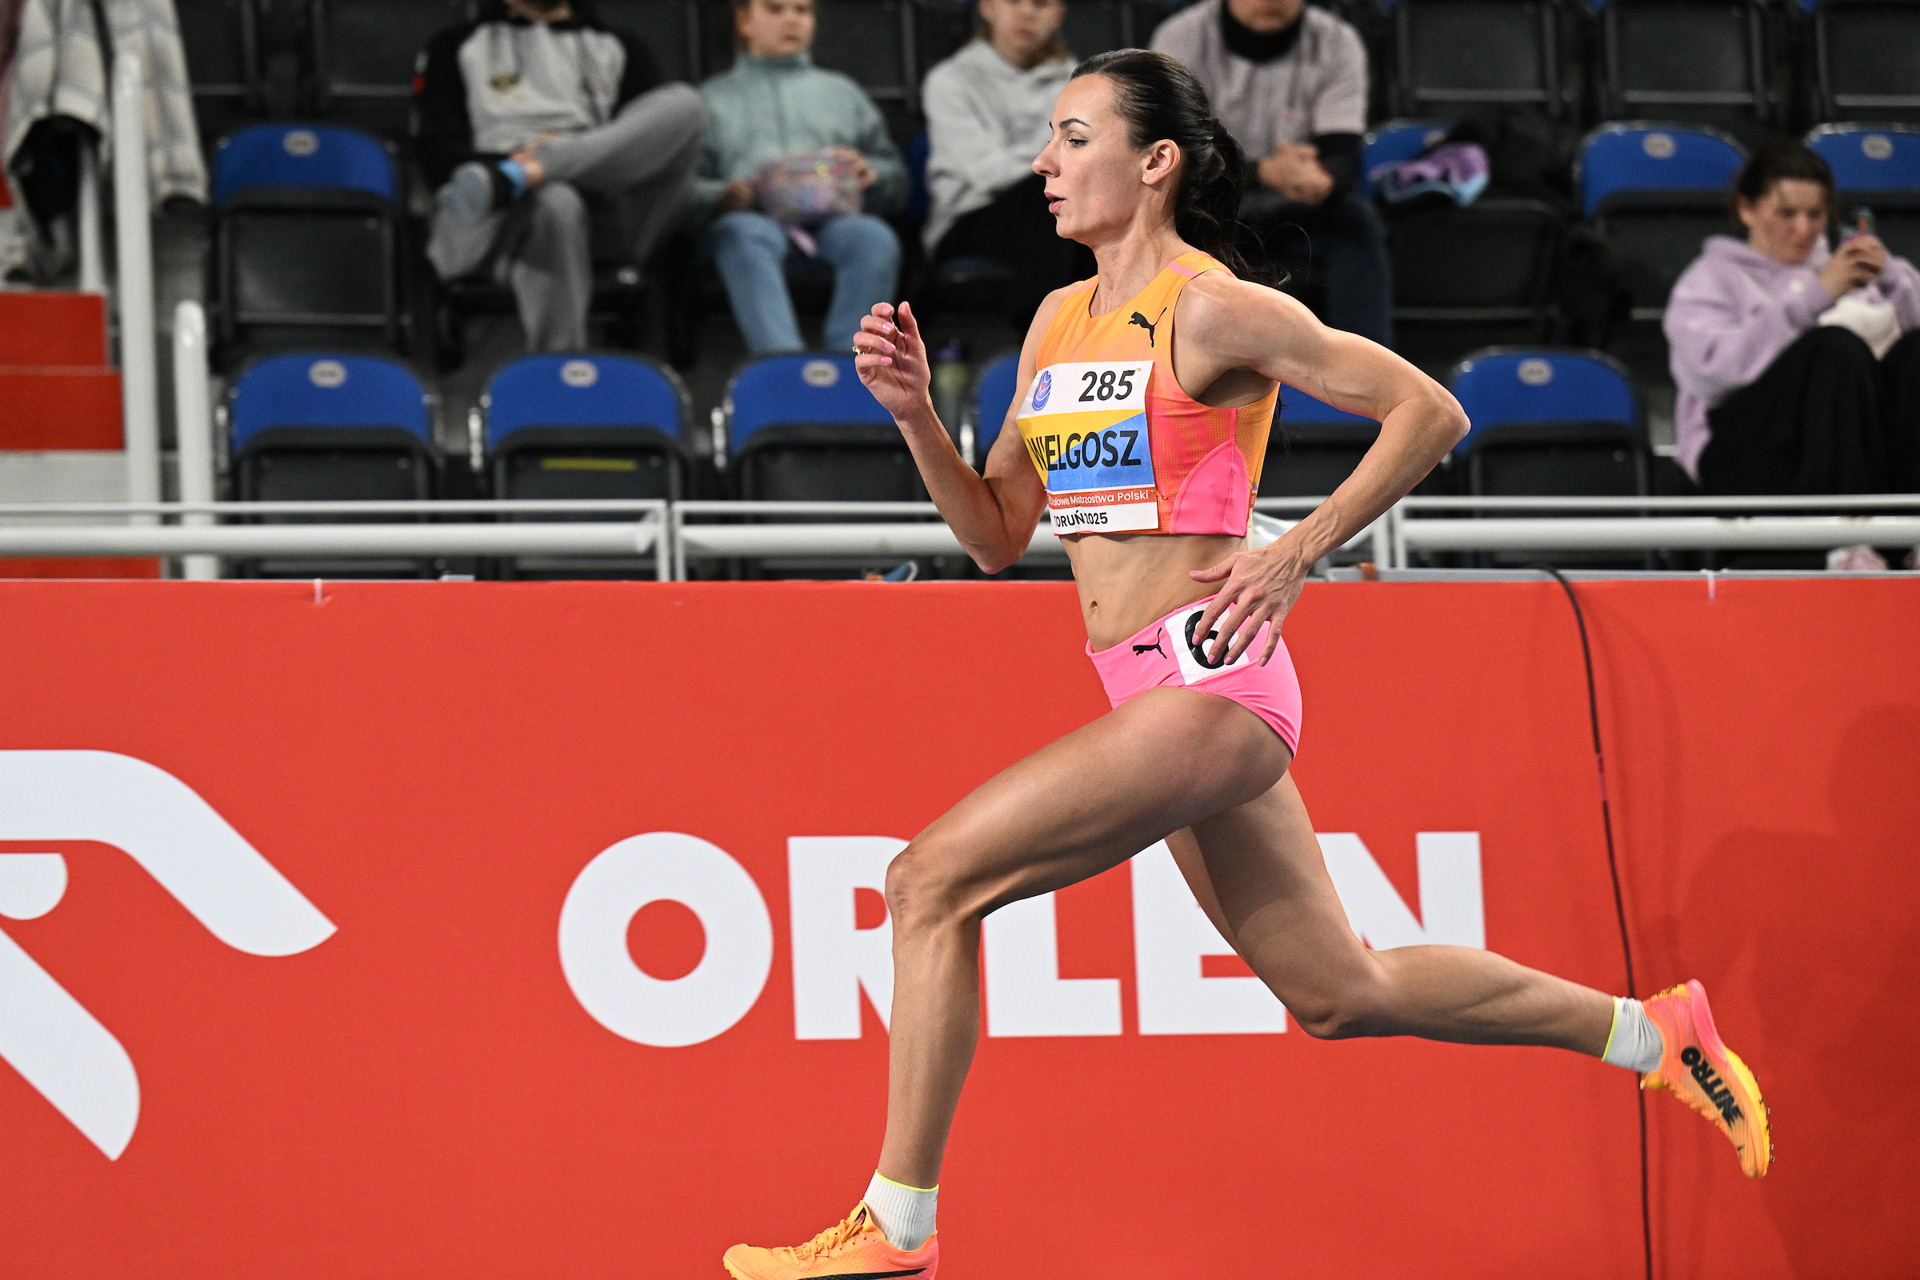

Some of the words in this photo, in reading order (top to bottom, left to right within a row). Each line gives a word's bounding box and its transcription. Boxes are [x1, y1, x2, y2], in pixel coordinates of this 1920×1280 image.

[1078, 370, 1136, 402] 285
[1117, 490, 1149, 502] Polski
[1053, 509, 1085, 528] ORUŃ
[1681, 1046, 1745, 1129] NITRO
